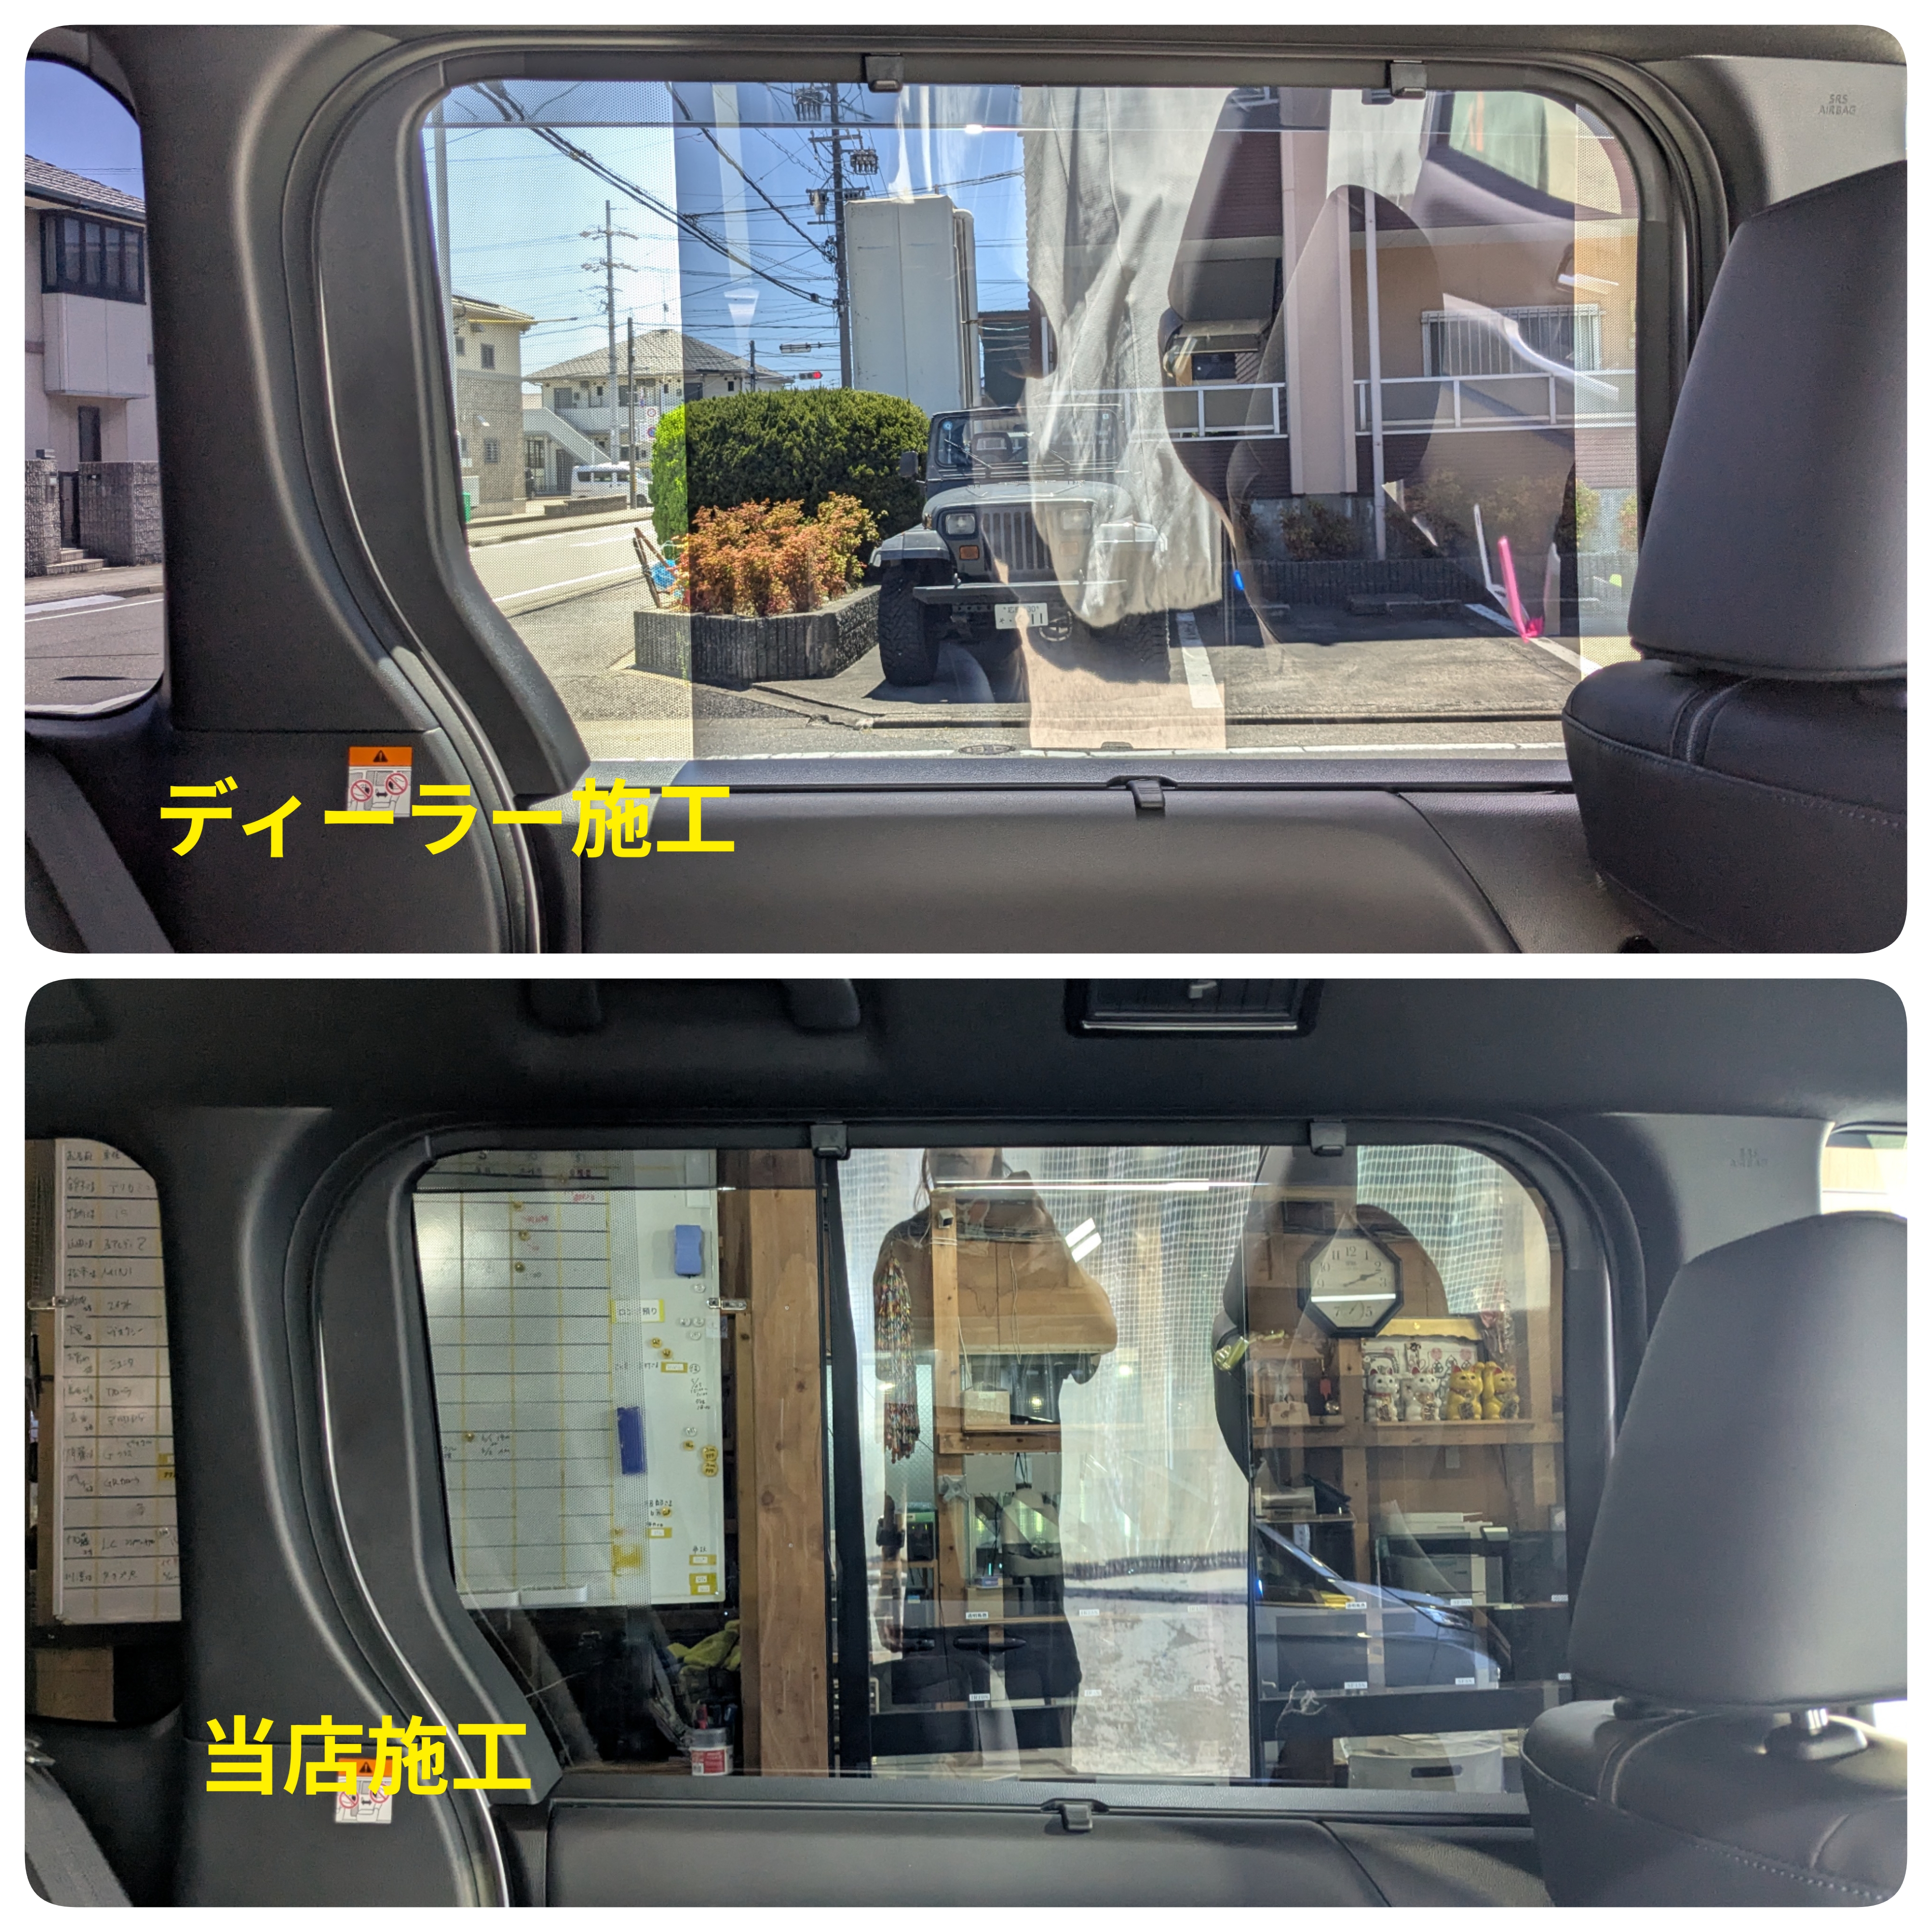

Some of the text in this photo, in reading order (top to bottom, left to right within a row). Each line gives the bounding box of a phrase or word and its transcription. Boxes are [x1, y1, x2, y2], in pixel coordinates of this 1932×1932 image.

[1828, 94, 1848, 104] SRS
[1817, 105, 1857, 115] AIRBAG
[1332, 1249, 1340, 1260] 11
[1345, 1246, 1357, 1257] 12
[1365, 1249, 1368, 1260] 1
[1320, 1262, 1331, 1273] 10
[1374, 1261, 1382, 1272] 2
[1316, 1279, 1325, 1289] 9
[1379, 1277, 1387, 1287] 3
[1333, 1306, 1341, 1317] 7
[1366, 1306, 1373, 1317] 5
